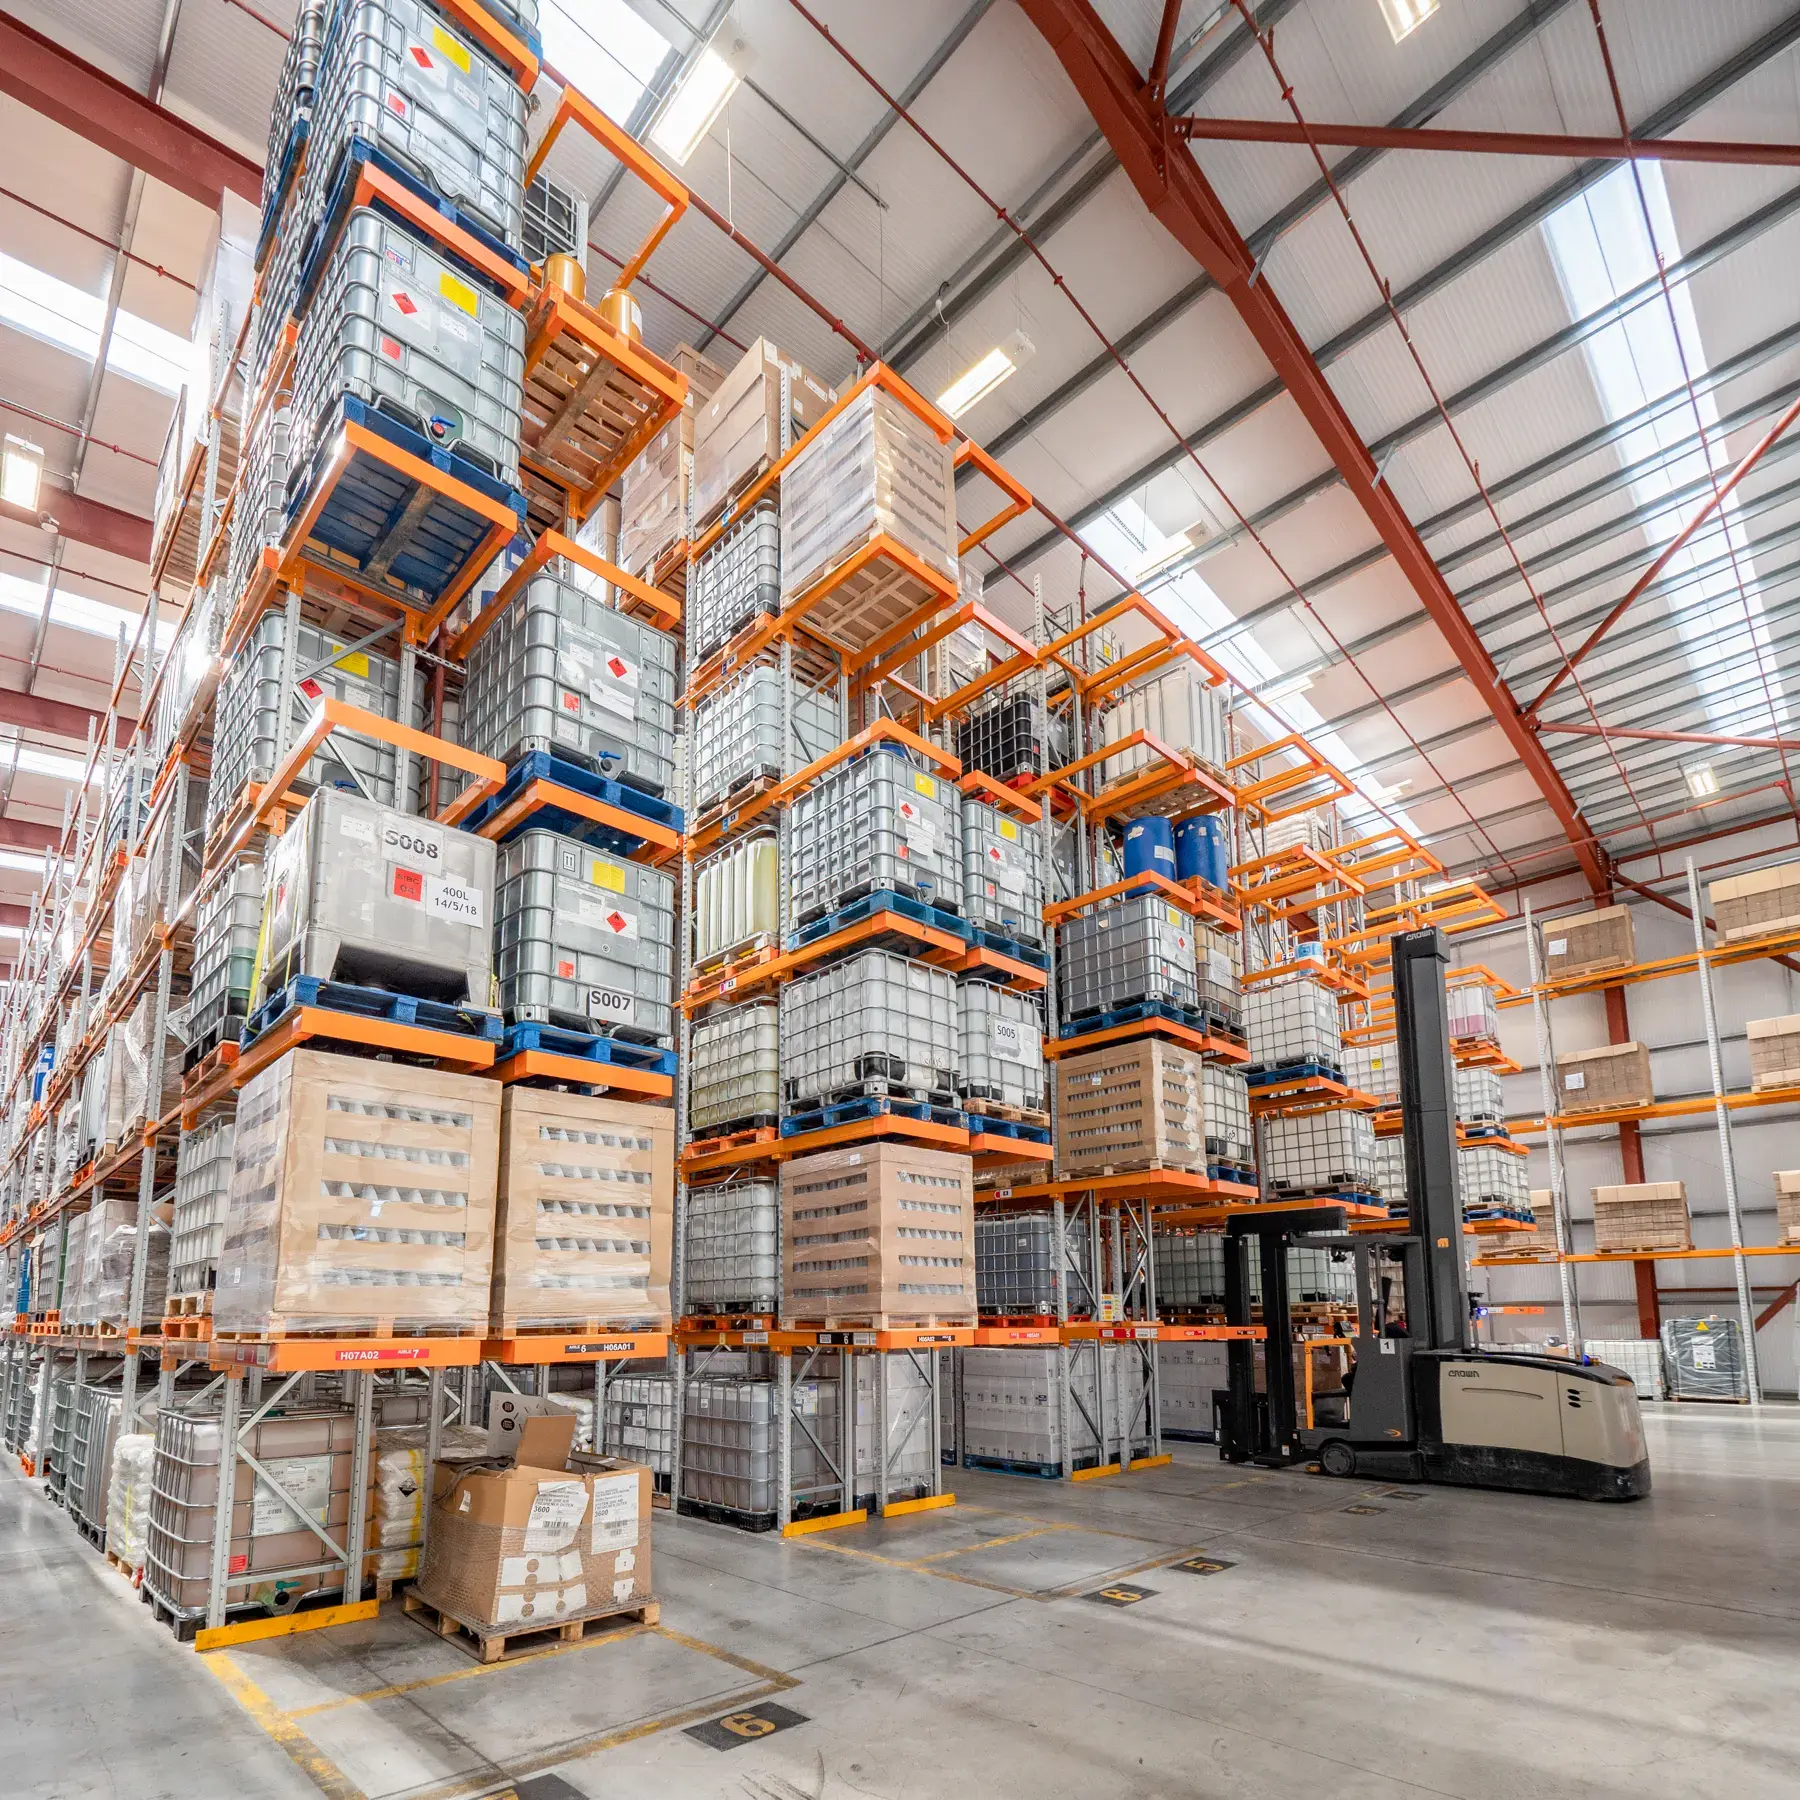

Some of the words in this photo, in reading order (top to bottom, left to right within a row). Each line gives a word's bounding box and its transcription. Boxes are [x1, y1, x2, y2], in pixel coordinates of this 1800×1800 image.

[385, 830, 438, 859] S008
[396, 873, 420, 885] SIBC
[442, 886, 469, 901] 400L
[434, 897, 478, 916] 14/5/18
[1405, 929, 1435, 942] CROWN
[591, 990, 631, 1011] S007
[997, 1024, 1016, 1039] S005
[843, 1335, 849, 1345] 6
[1384, 1341, 1390, 1350] 1
[581, 1344, 587, 1353] 6
[340, 1350, 379, 1361] H07A02
[412, 1349, 420, 1358] 7
[1448, 1369, 1480, 1378] CROWN
[594, 1509, 609, 1518] 3600
[1183, 1560, 1224, 1571] 5
[1099, 1588, 1143, 1601] 6
[719, 1712, 777, 1737] 6
